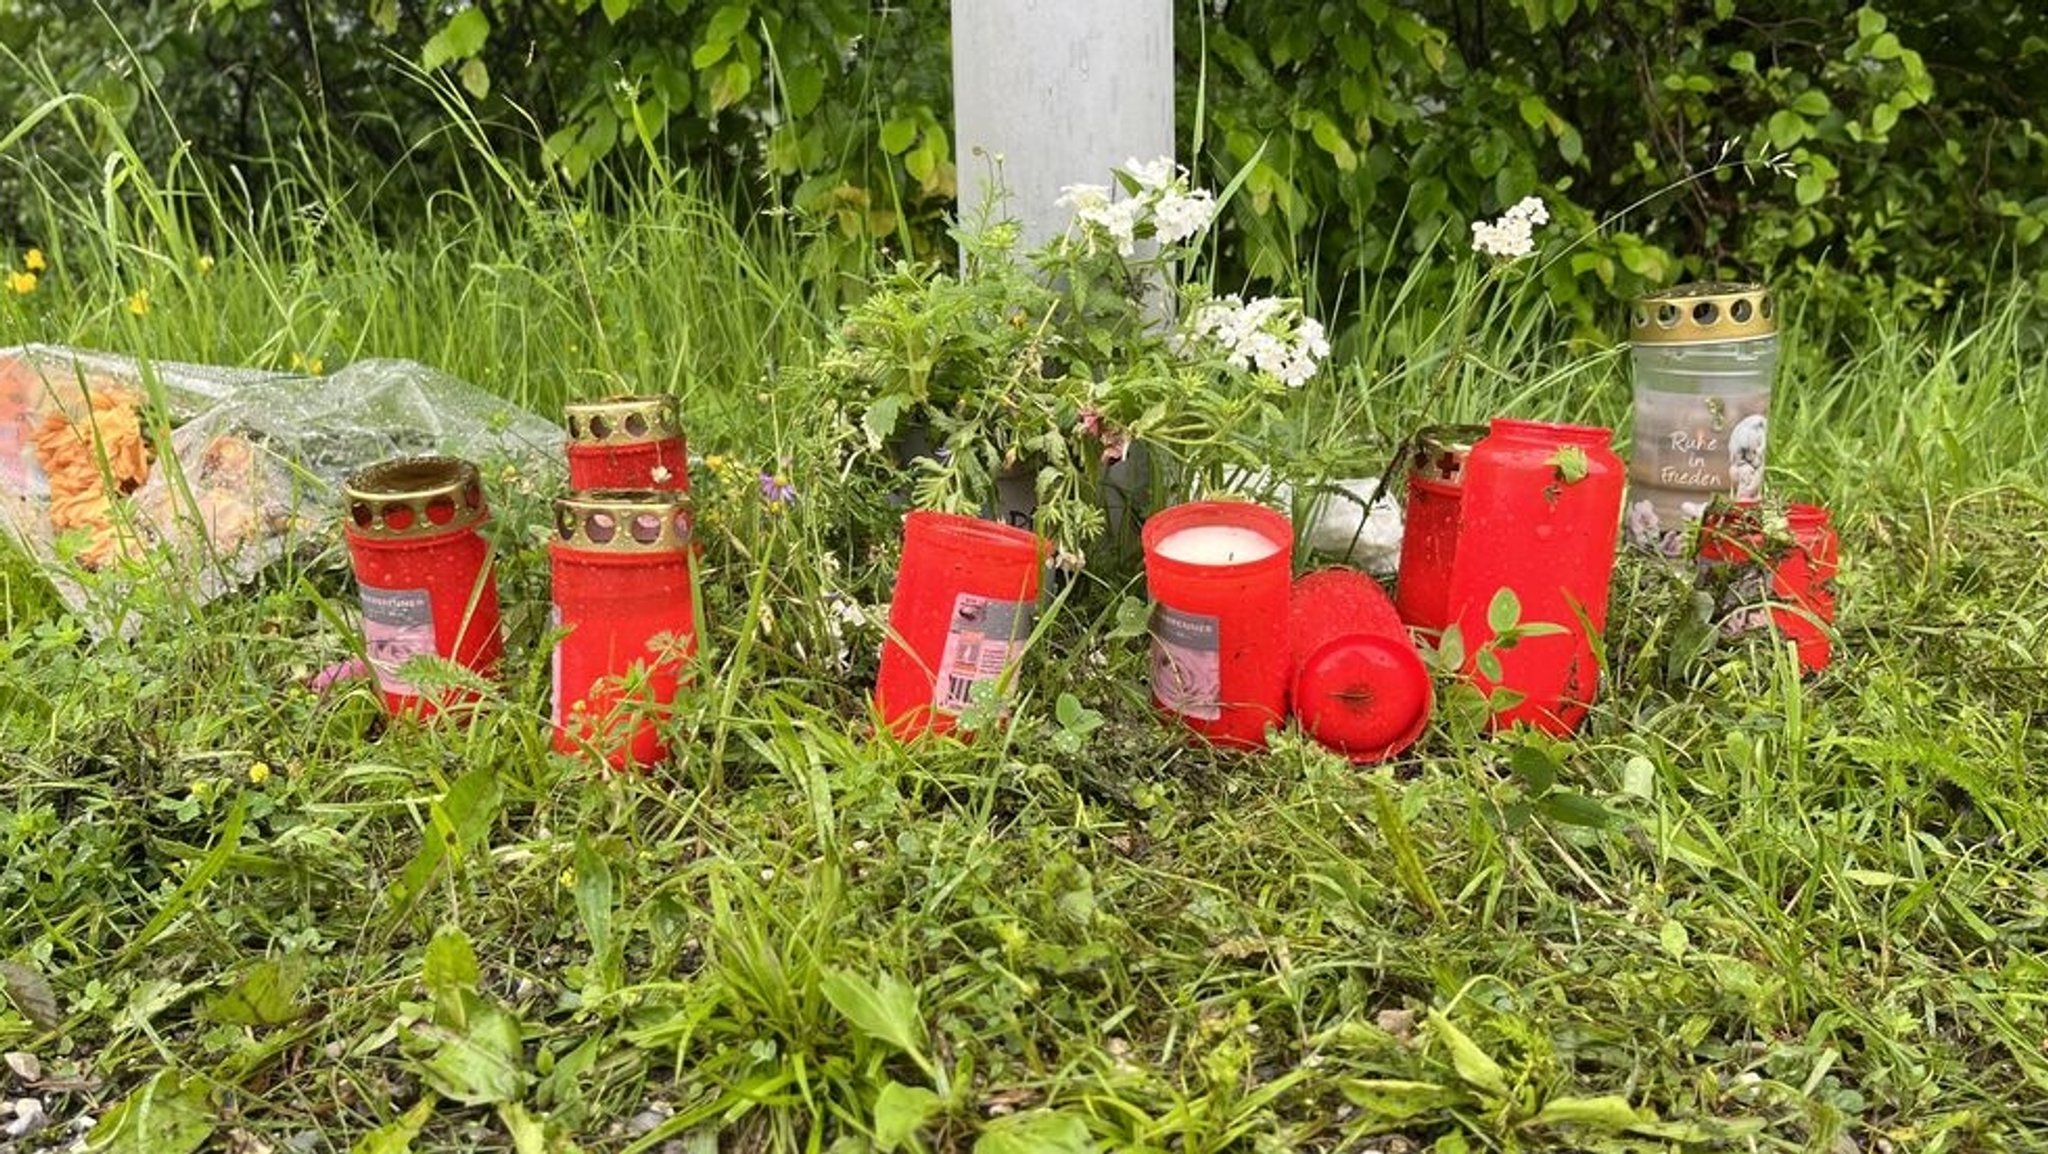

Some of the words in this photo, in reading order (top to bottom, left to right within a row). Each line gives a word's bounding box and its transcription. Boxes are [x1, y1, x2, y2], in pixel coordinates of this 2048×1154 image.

[1670, 430, 1718, 454] Ruhe
[1688, 452, 1705, 468] in
[1661, 466, 1722, 487] Frieden
